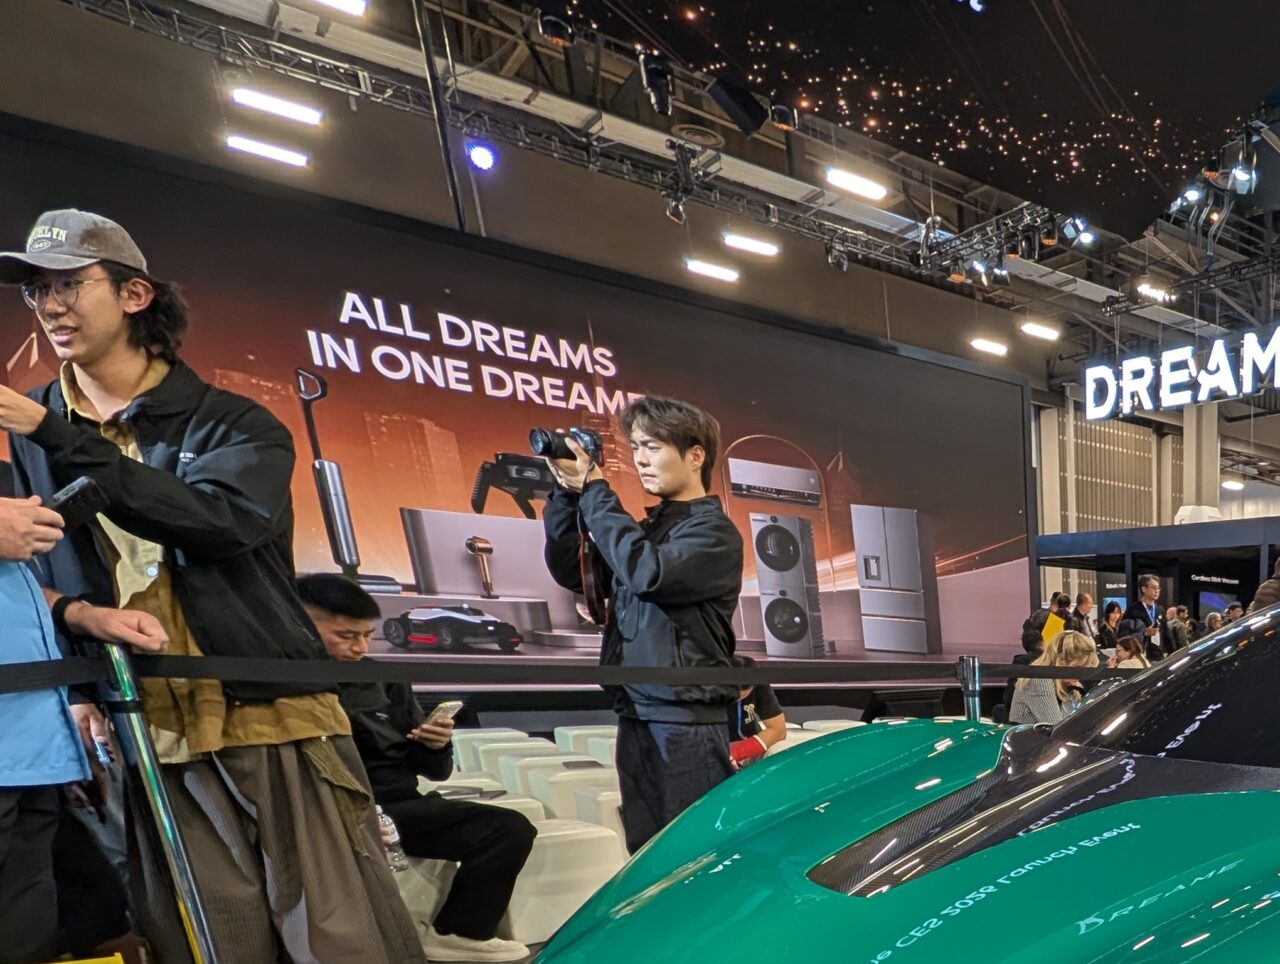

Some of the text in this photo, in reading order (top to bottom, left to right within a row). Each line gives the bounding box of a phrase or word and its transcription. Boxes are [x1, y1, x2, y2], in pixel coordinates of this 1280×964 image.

[306, 330, 360, 373] IN
[371, 345, 472, 393] ONE
[339, 292, 617, 377] ALL DREAMS
